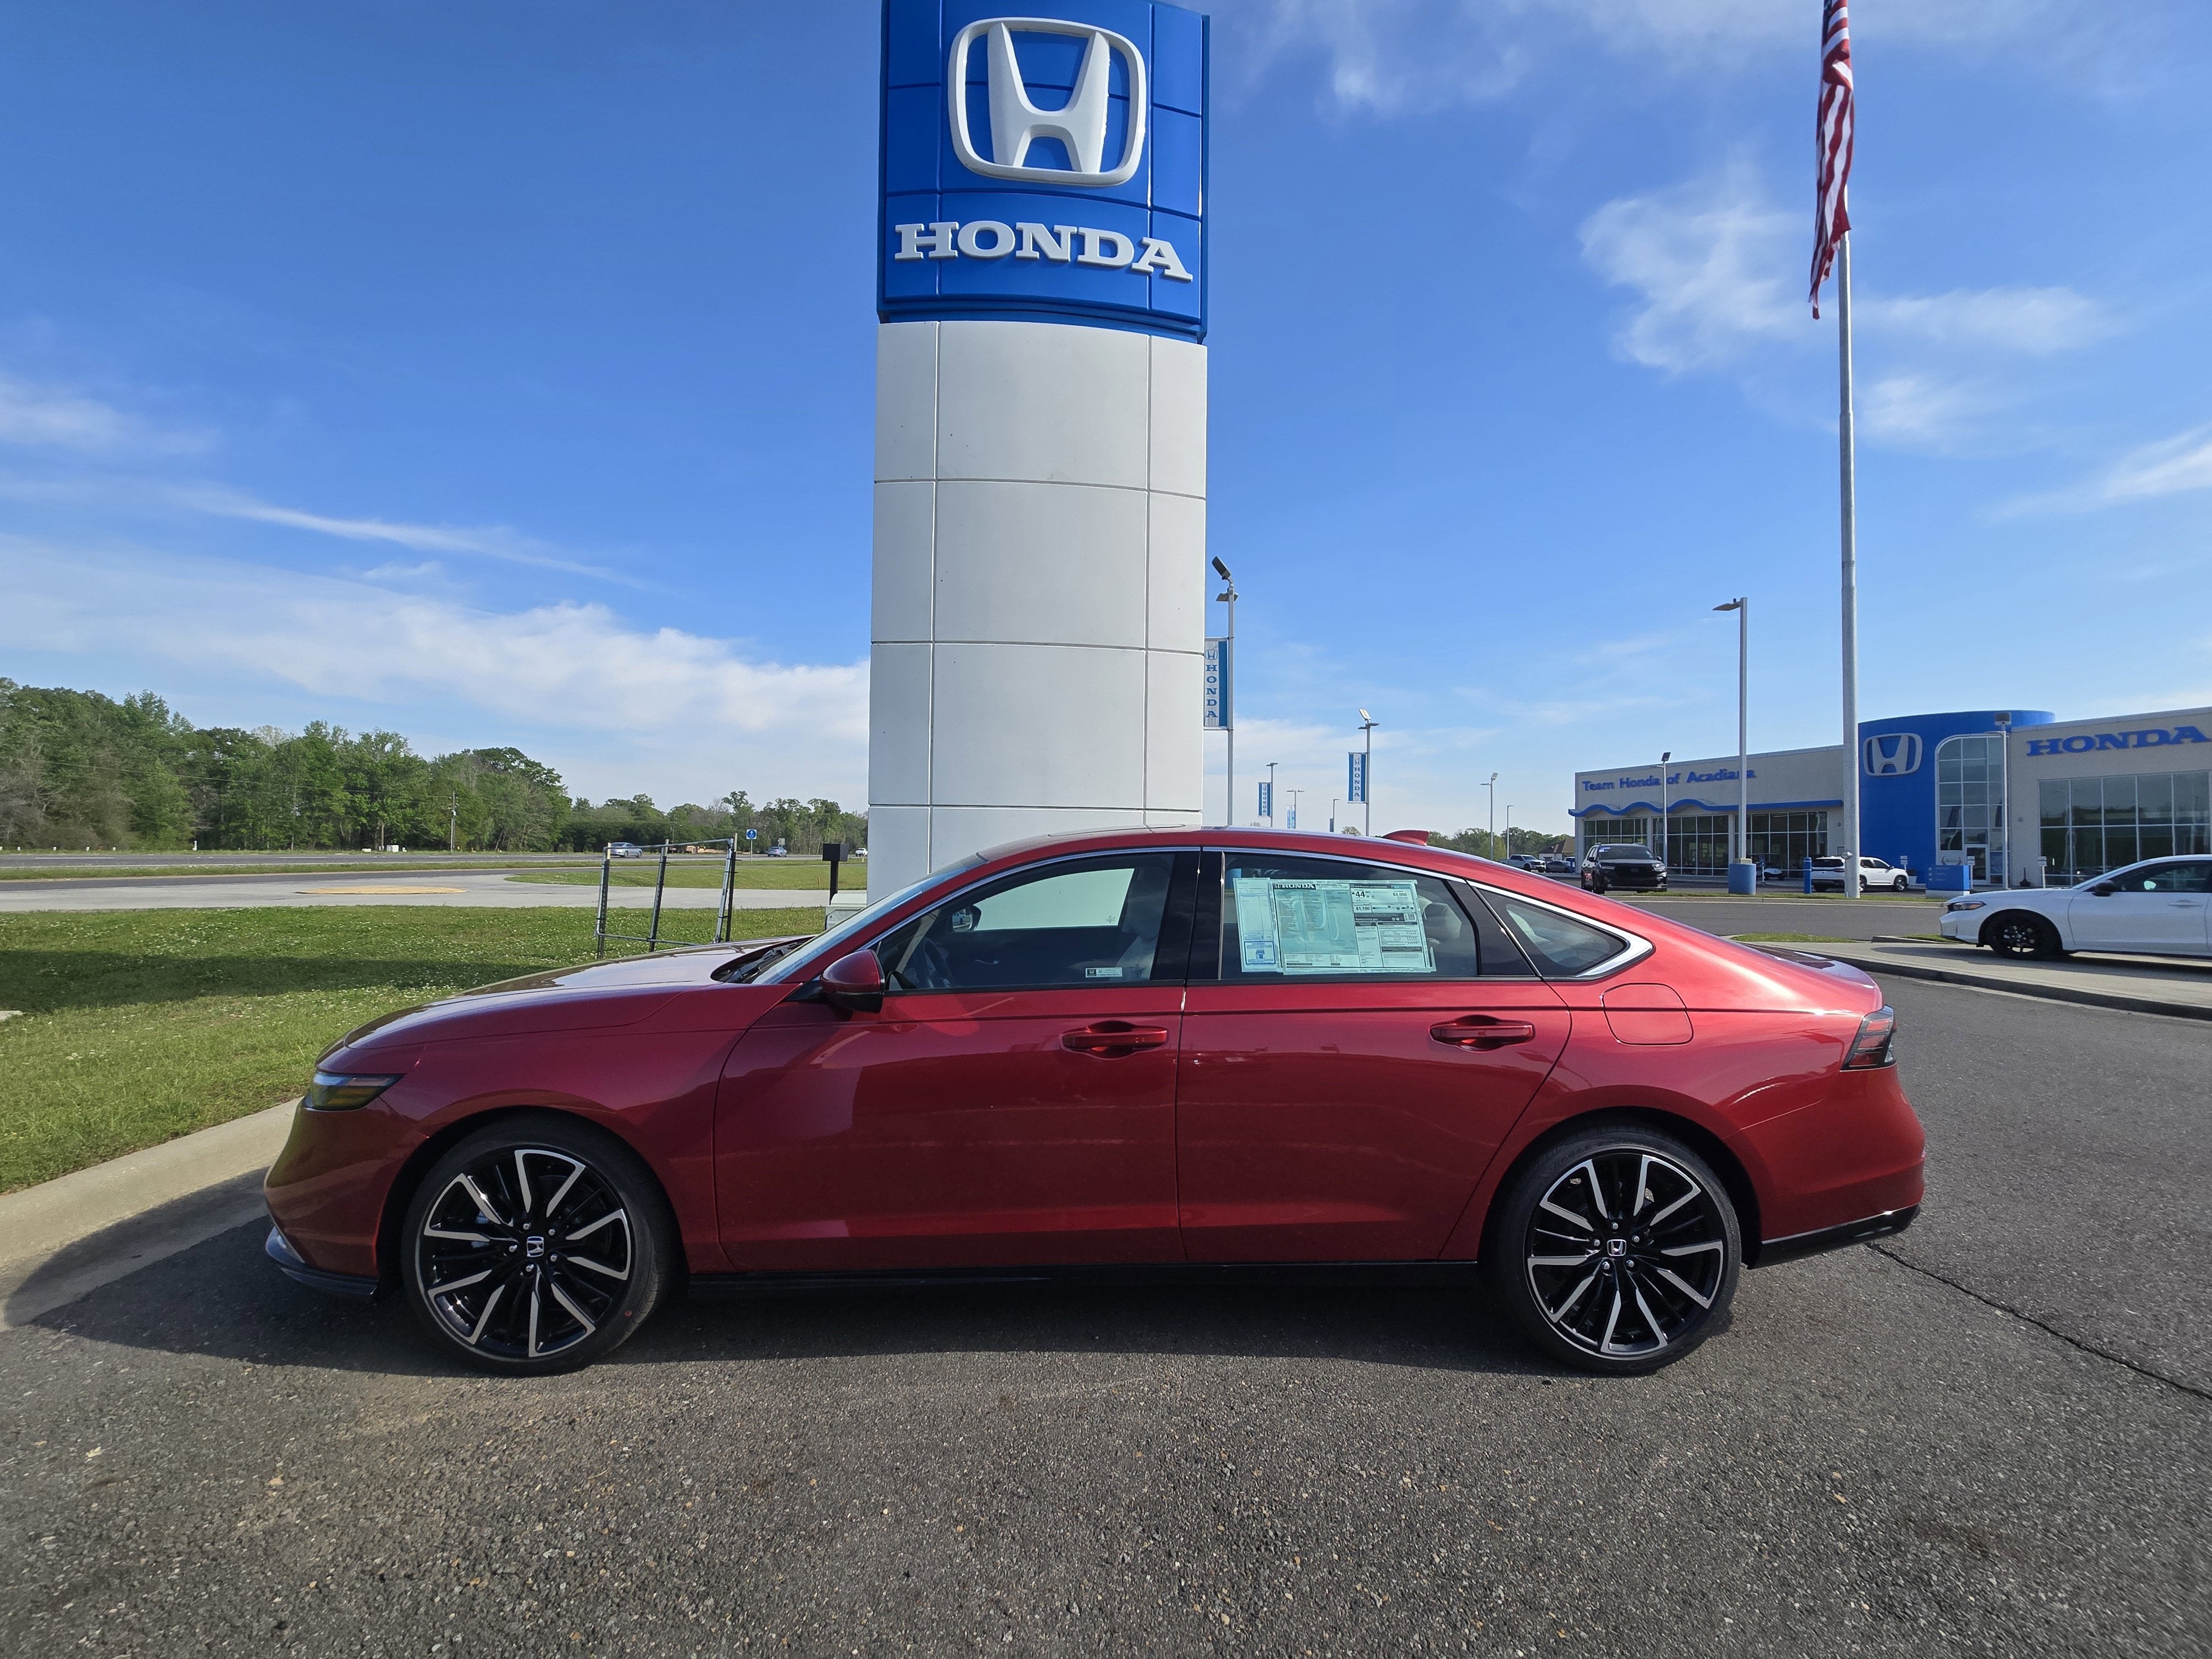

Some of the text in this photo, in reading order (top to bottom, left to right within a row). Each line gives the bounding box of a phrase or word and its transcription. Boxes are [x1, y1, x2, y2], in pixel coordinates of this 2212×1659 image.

[894, 220, 1193, 282] HONDA
[1206, 665, 1218, 718] HONDA
[2026, 726, 2212, 757] HONDA
[1582, 780, 1615, 791] Team
[1619, 775, 1662, 789] Honda
[1666, 773, 1682, 784] of
